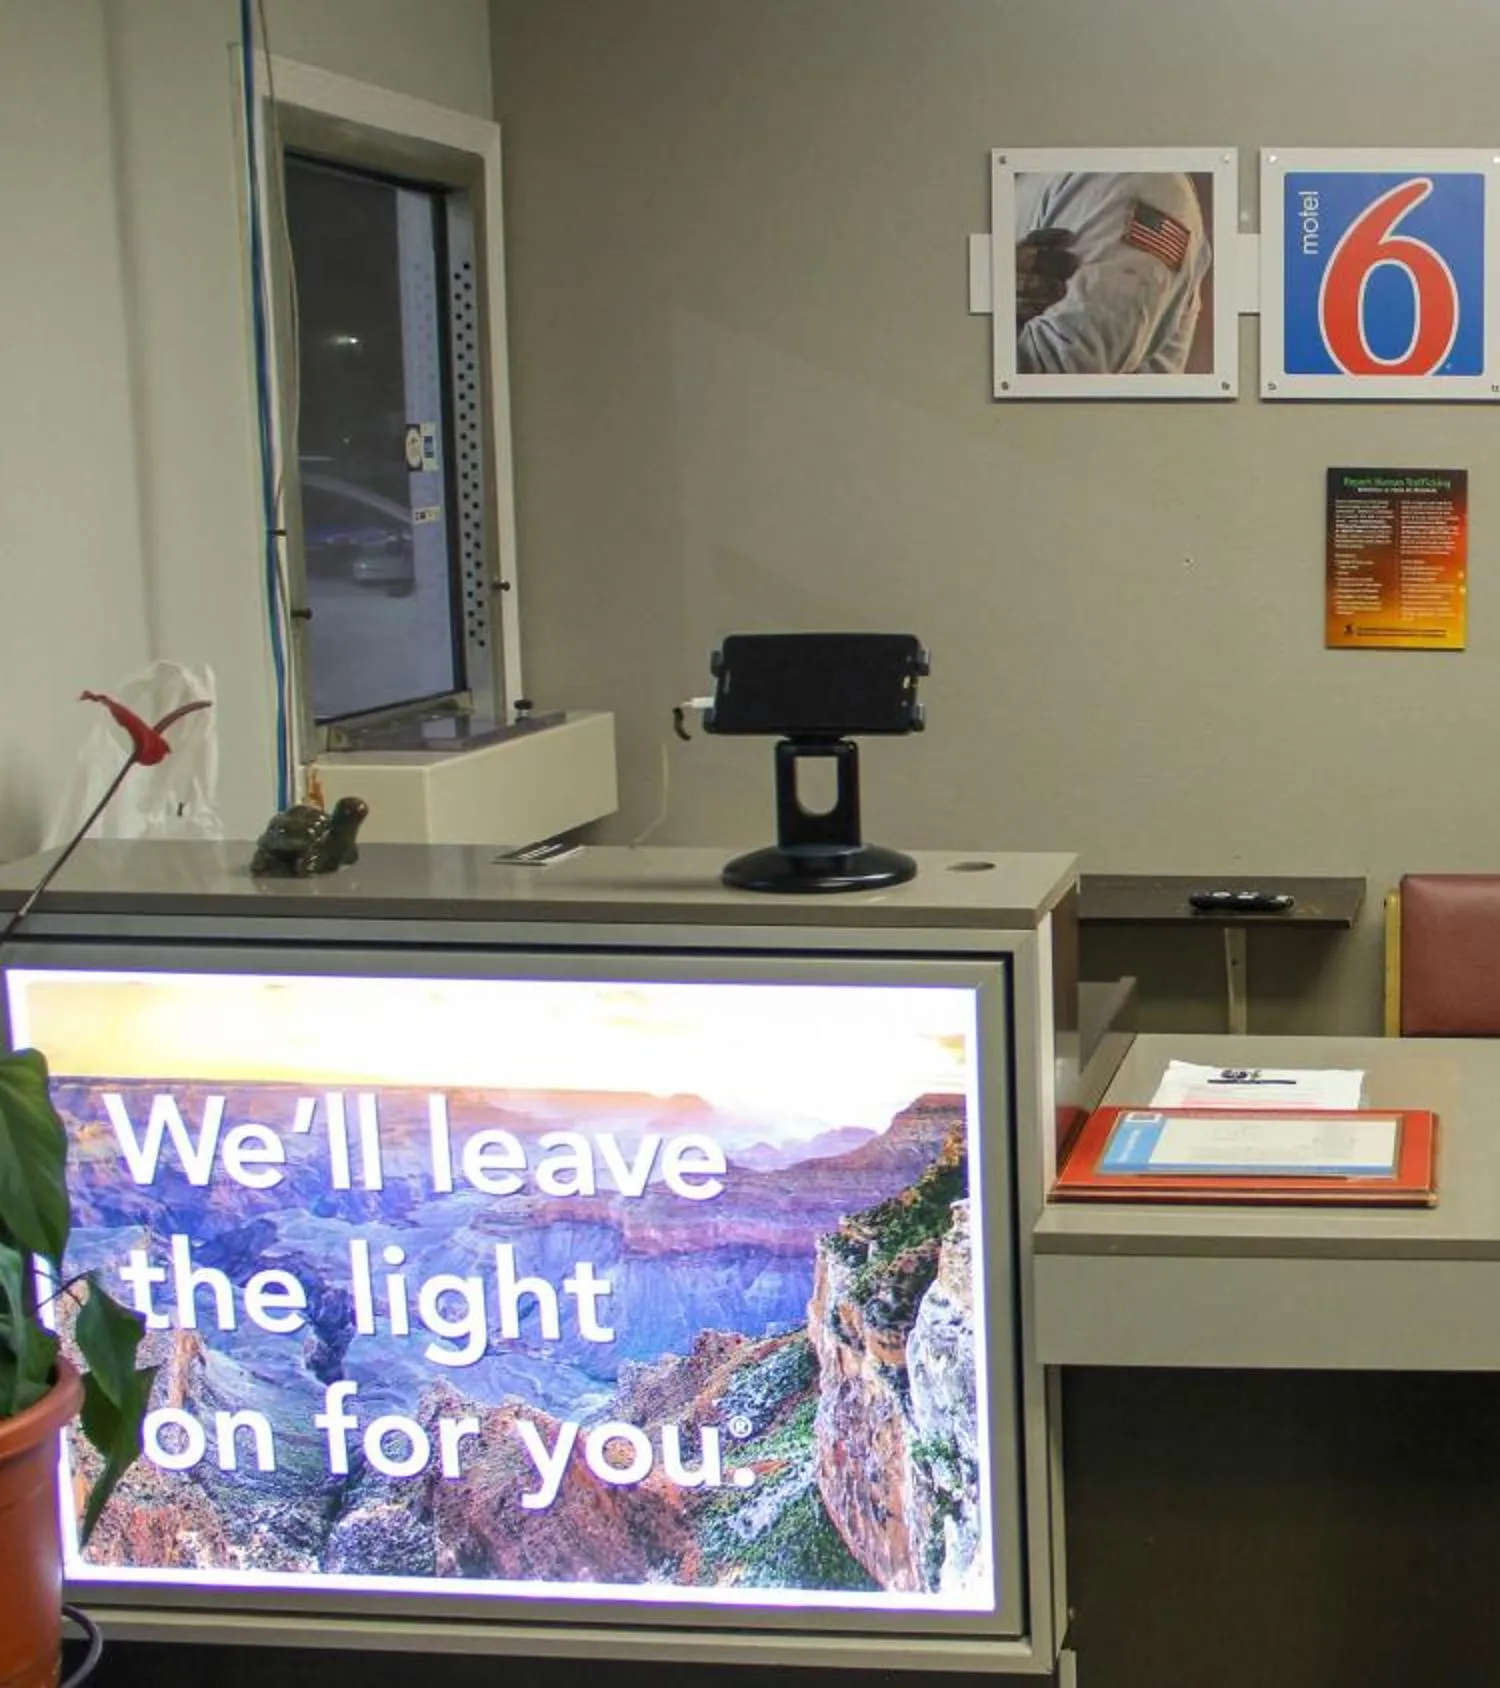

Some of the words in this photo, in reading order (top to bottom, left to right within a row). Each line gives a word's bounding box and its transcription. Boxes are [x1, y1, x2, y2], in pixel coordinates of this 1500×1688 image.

[1298, 191, 1319, 255] motel
[1318, 177, 1459, 377] 6
[103, 1091, 382, 1190] We'll
[428, 1092, 728, 1200] leave
[119, 1235, 307, 1333] the
[350, 1238, 615, 1367] light
[143, 1406, 275, 1470] on
[315, 1380, 480, 1478] for
